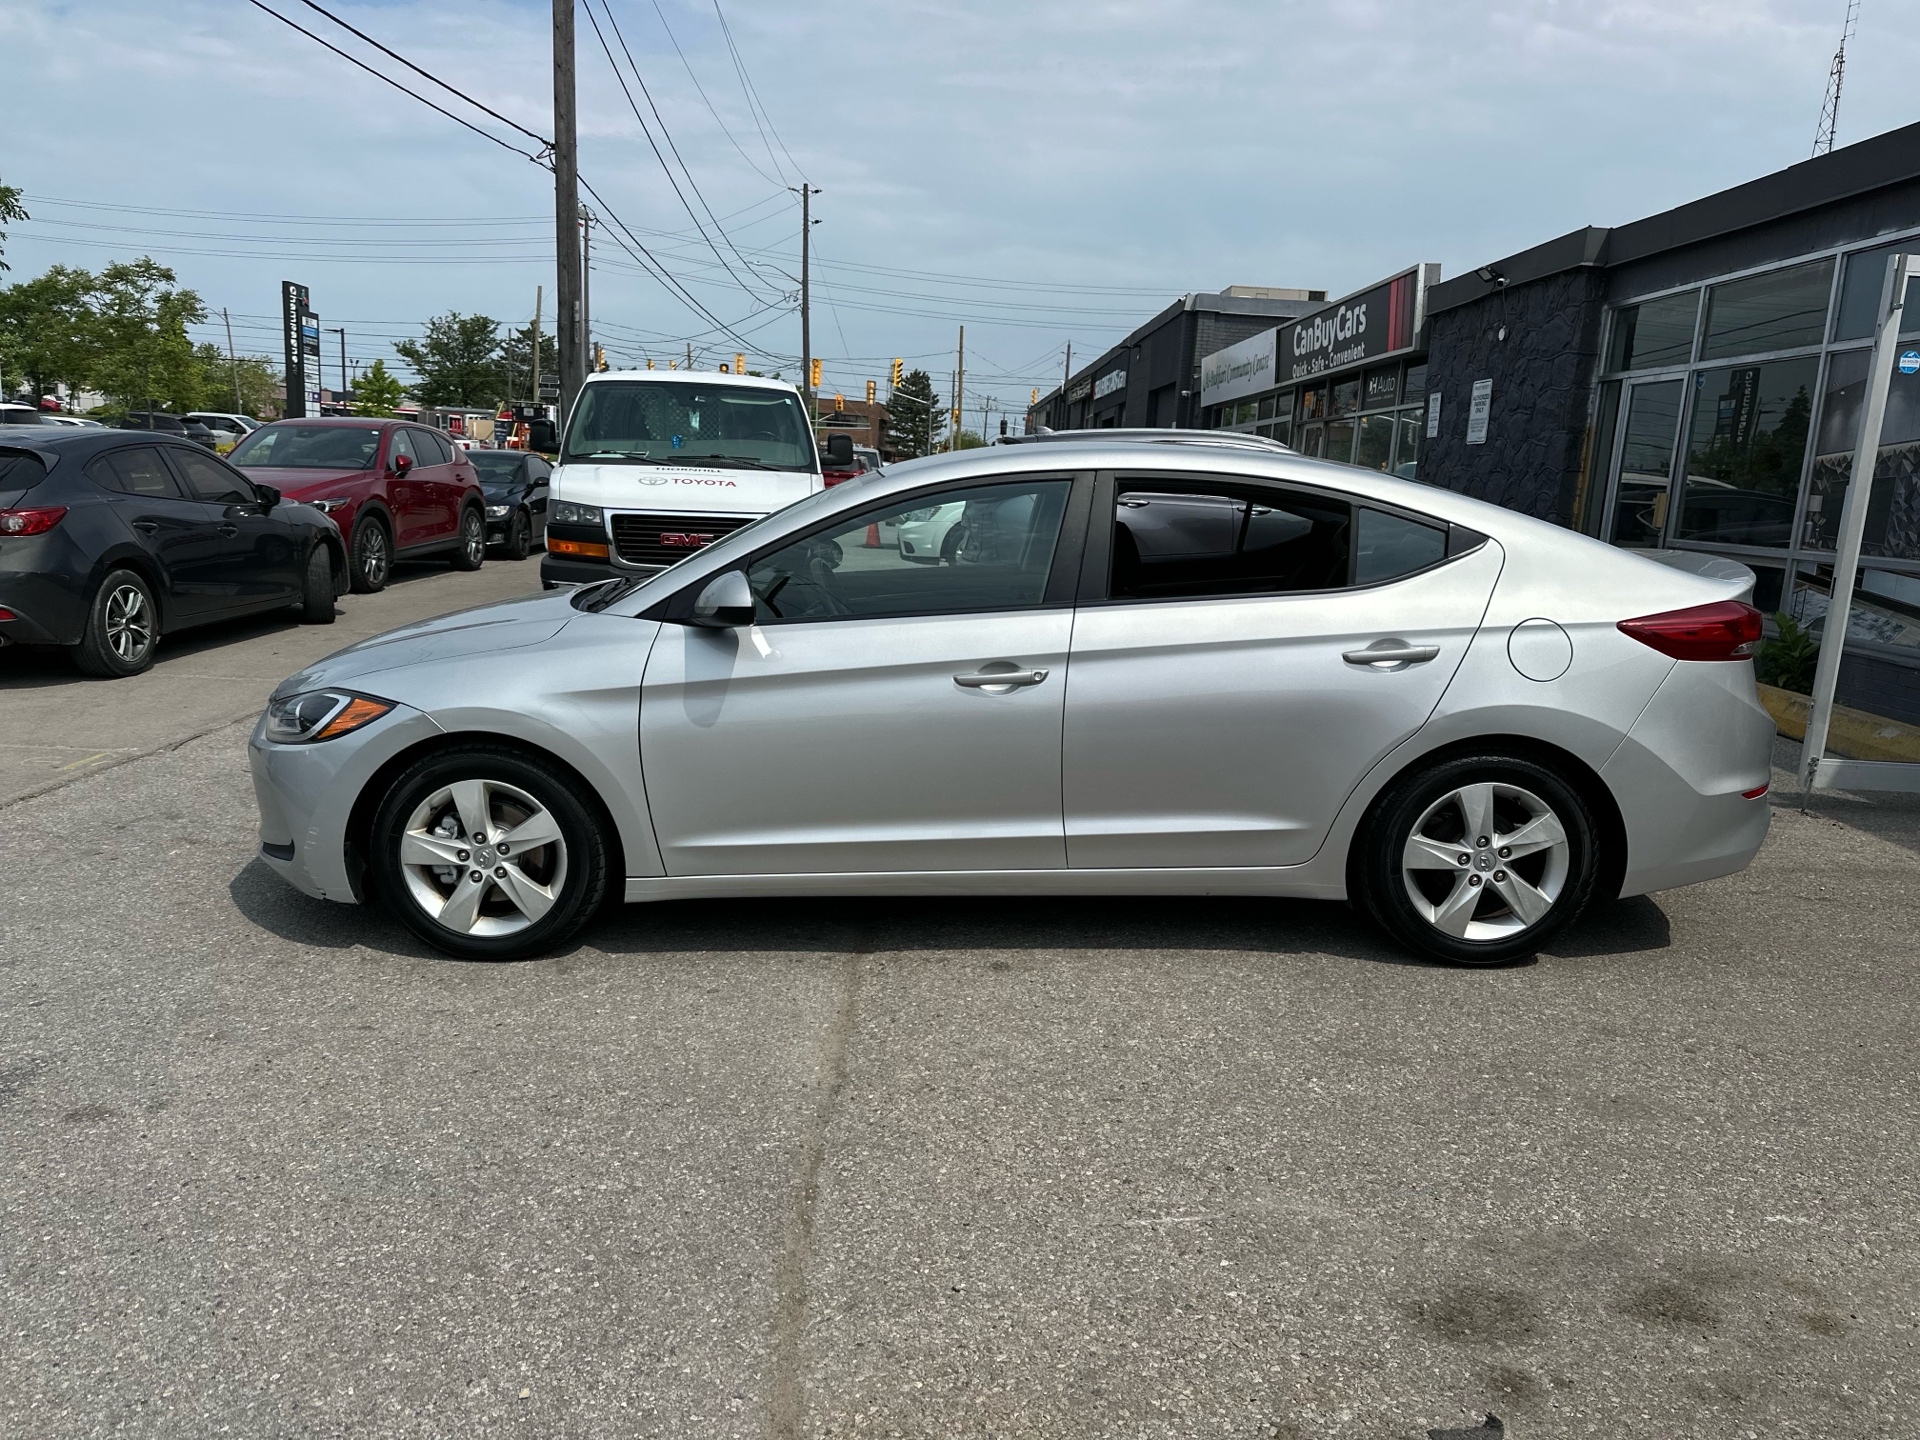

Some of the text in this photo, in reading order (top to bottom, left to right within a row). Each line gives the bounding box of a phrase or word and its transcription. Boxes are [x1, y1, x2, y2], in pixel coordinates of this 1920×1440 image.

[289, 285, 298, 364] Champagne
[1293, 303, 1367, 357] CanBuyCars
[1292, 360, 1308, 379] Quick
[1311, 355, 1324, 373] Safe
[1329, 341, 1365, 368] Convenient
[1377, 375, 1396, 394] Auto
[671, 478, 737, 488] TOYOTA
[660, 533, 714, 547] GMC
